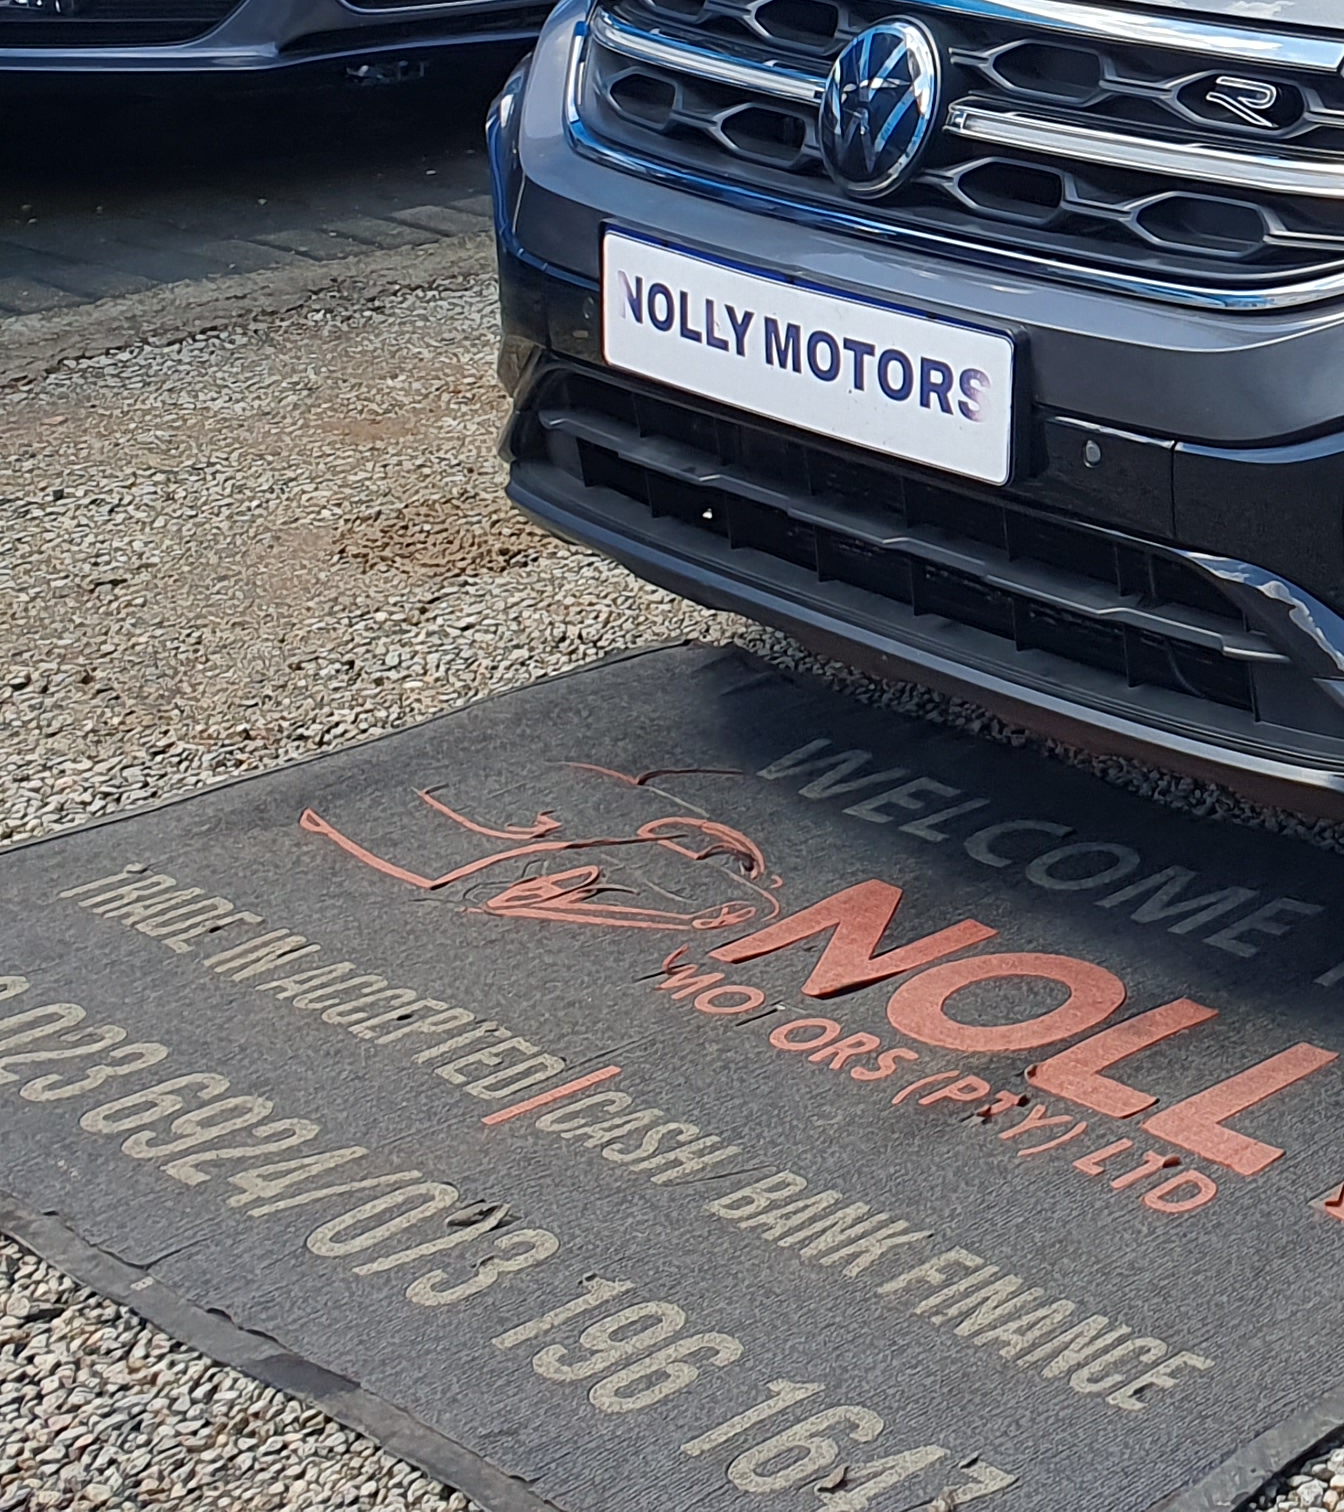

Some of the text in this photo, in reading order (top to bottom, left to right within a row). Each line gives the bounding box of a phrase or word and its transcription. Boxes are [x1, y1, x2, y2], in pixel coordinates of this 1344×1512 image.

[616, 269, 991, 423] NOLLY MOTORS
[58, 862, 266, 954] TRADE
[756, 737, 1324, 958] WELCOME
[203, 928, 321, 982] IN
[255, 962, 566, 1100] ACCEPTED
[656, 944, 920, 1080] MOORS
[1072, 1138, 1218, 1213] LTD
[705, 1169, 934, 1278] BANK
[491, 1273, 744, 1413] 196
[877, 1245, 1215, 1410] FINANCE
